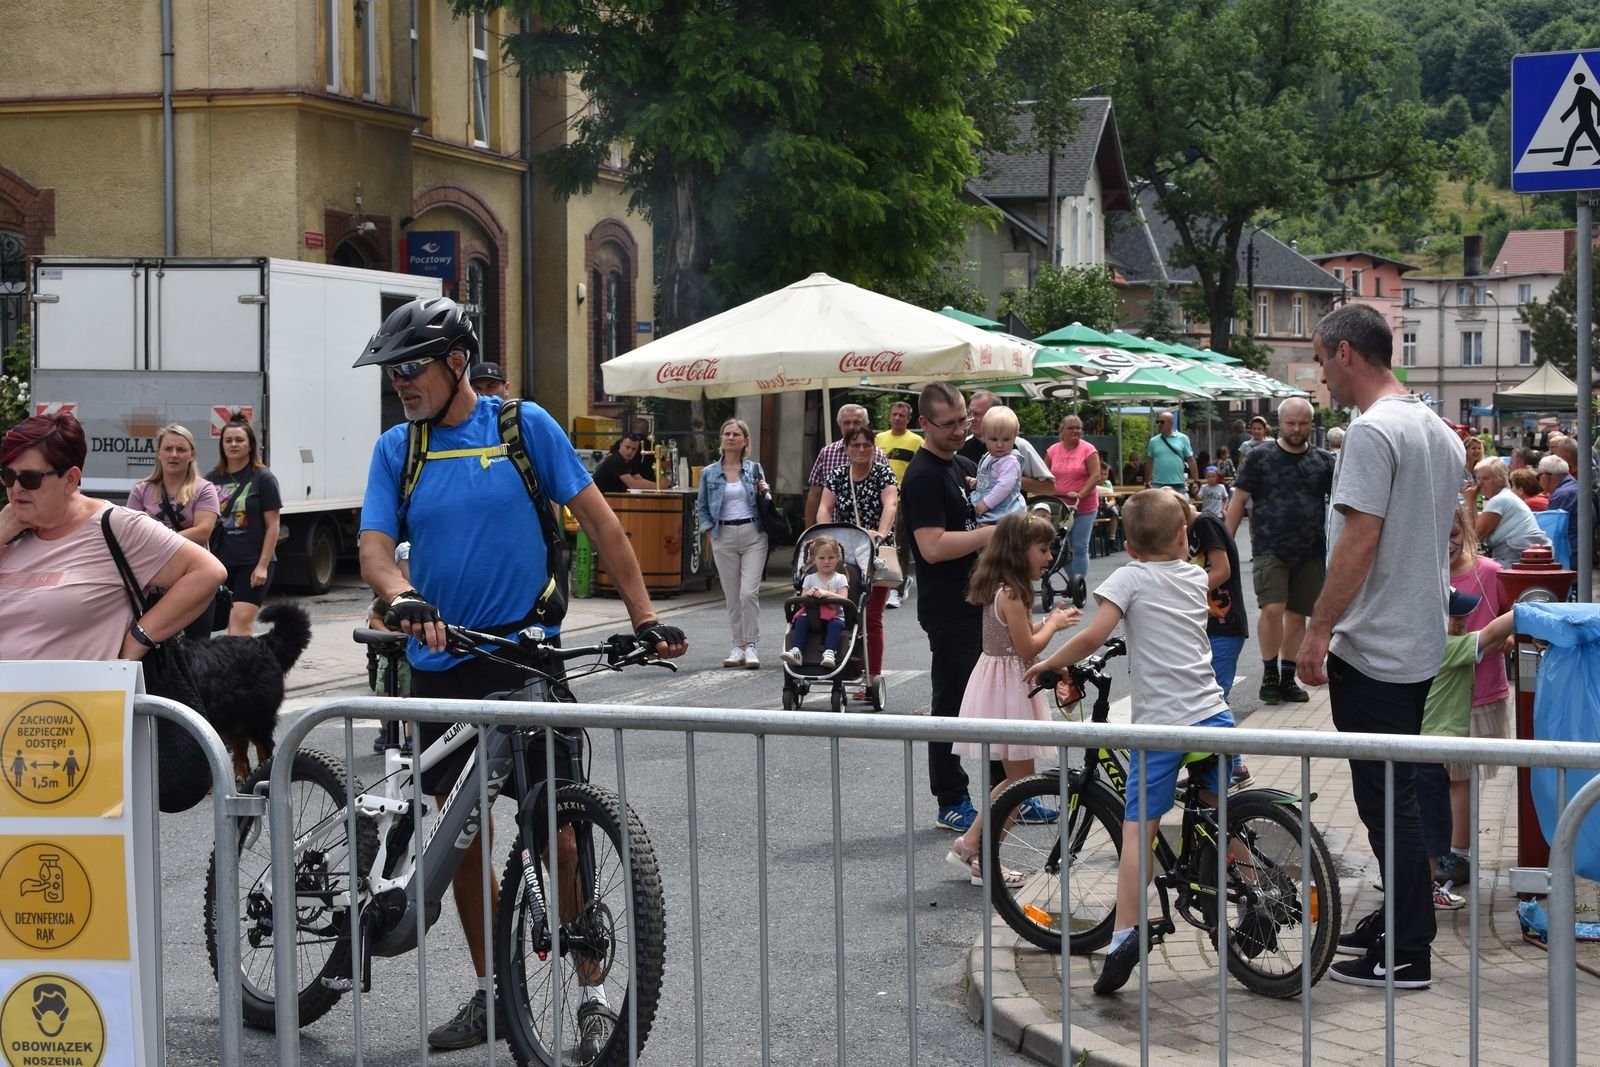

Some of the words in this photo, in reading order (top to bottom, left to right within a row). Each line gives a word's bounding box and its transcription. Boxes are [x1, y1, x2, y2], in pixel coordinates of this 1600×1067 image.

[410, 255, 452, 265] Pocztowy
[838, 351, 906, 373] Coca-Cola
[656, 358, 721, 384] Coca-Cola
[91, 437, 157, 453] DHOLLA
[20, 715, 73, 725] ZACHOWAJ
[17, 727, 75, 737] BEZPIECZNY
[25, 738, 66, 750] ODSTĘP!
[31, 776, 59, 789] 1,5m
[556, 801, 586, 812] AXXIS
[15, 912, 75, 925] DEZYNFEKCJA
[36, 928, 55, 943] RĄK
[11, 1040, 94, 1054] OBOWIĄZEK
[23, 1056, 83, 1066] NOSZENIA
